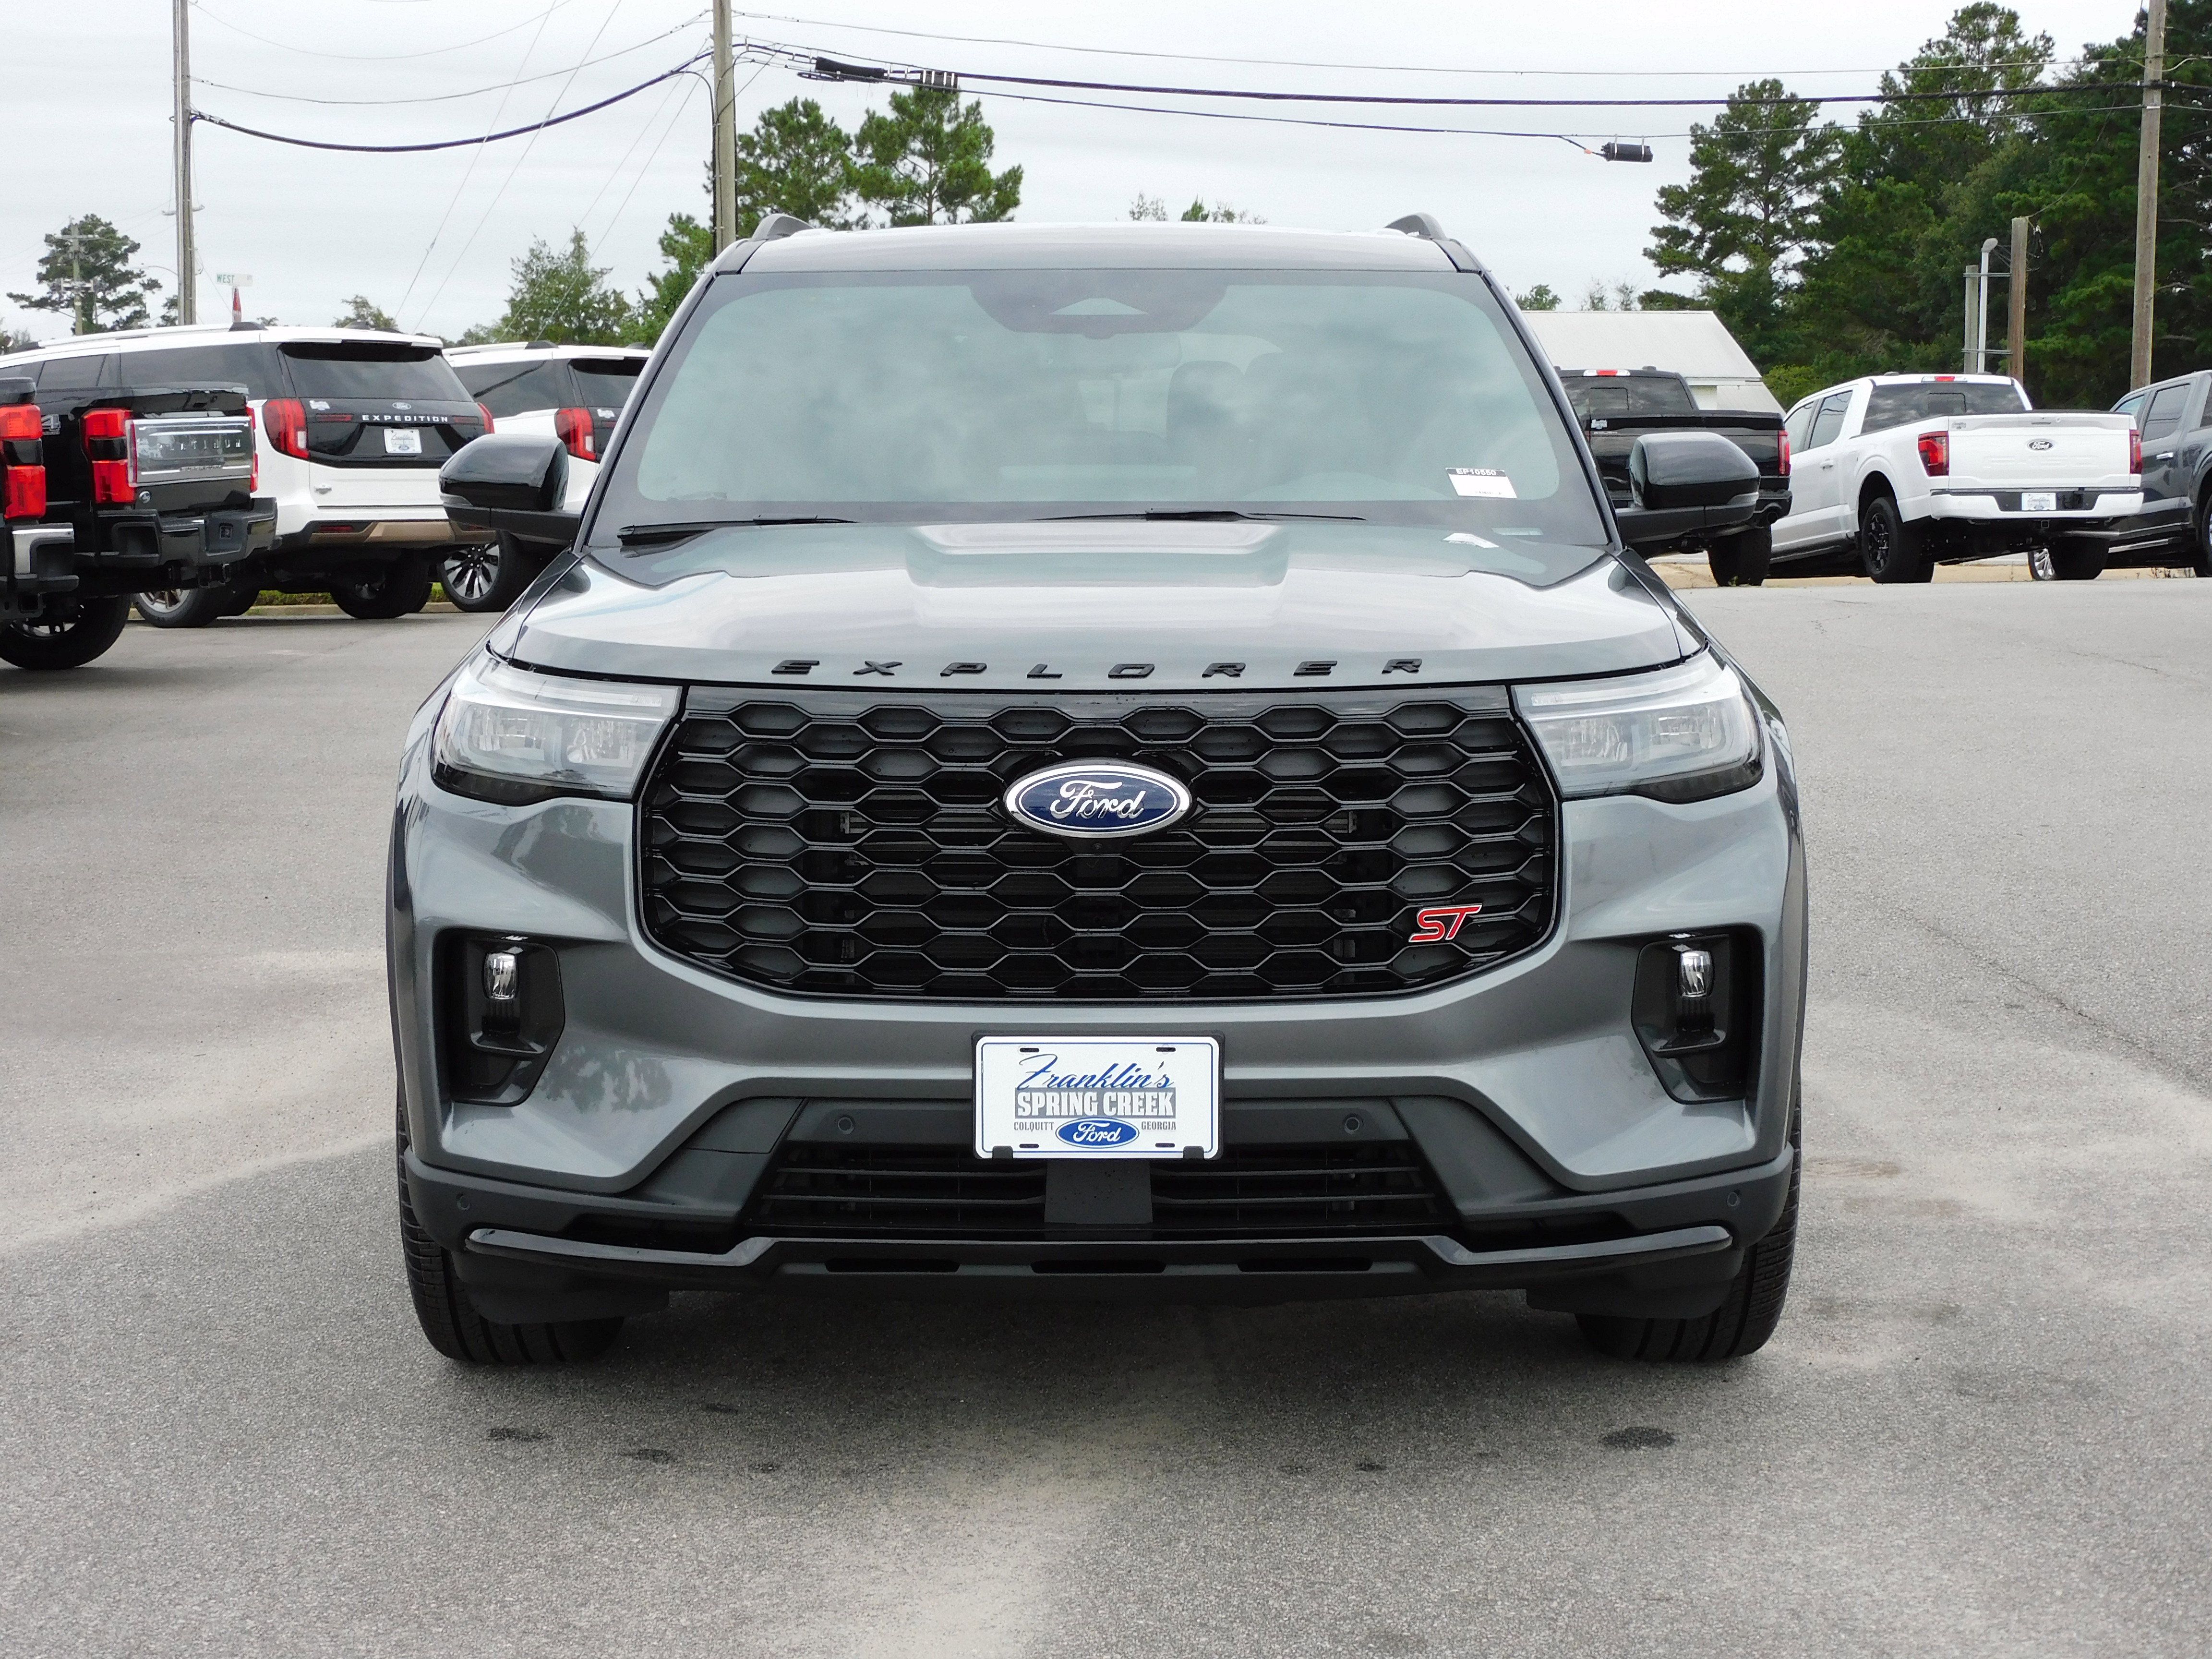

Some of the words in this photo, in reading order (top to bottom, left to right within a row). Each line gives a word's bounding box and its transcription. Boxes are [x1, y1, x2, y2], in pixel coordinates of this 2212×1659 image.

[216, 274, 235, 284] WEST
[2032, 441, 2050, 449] Ford
[770, 658, 1423, 678] EXPLORER
[1049, 780, 1147, 819] Ford
[1408, 902, 1483, 943] ST
[1017, 1053, 1175, 1091] Franklin's
[1017, 1091, 1098, 1117] SPRING
[1103, 1091, 1175, 1117] CREEK
[1013, 1121, 1055, 1132] COLQUITT
[1072, 1121, 1122, 1142] Ford
[1141, 1120, 1177, 1131] GEORGIA
